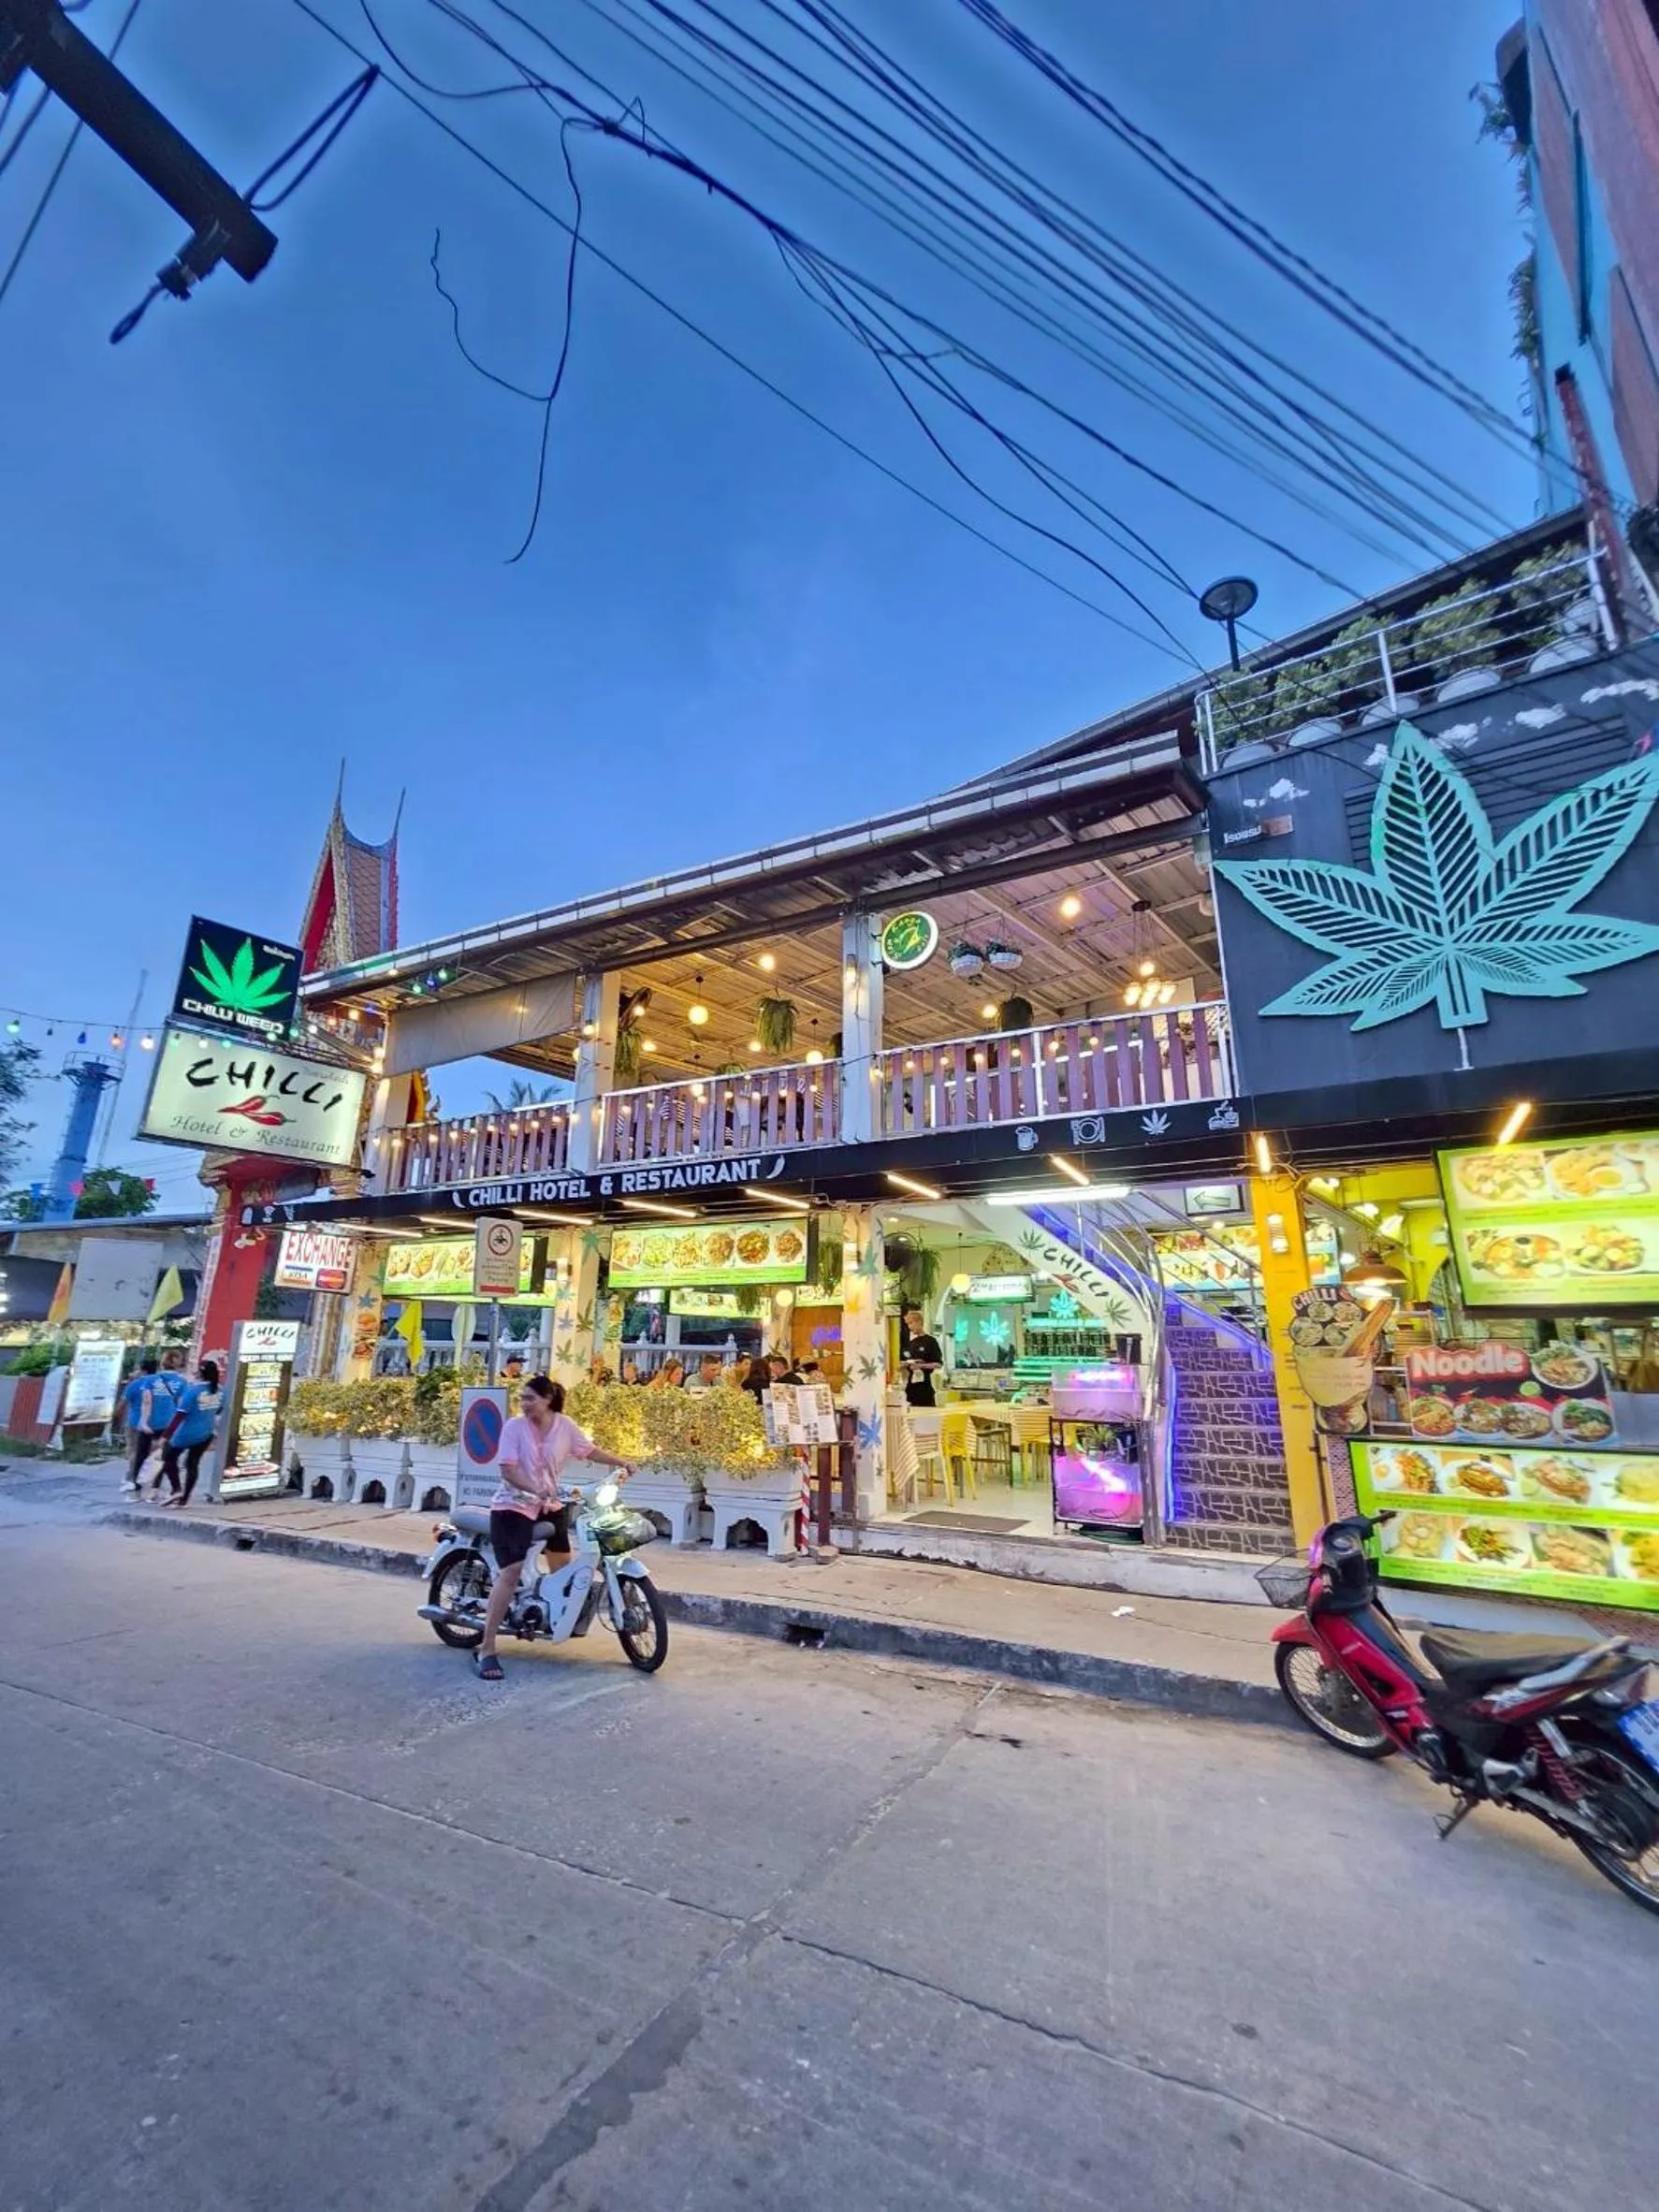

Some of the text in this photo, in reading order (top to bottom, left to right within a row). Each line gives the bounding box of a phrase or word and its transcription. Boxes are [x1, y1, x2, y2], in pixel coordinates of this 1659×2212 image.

[182, 997, 284, 1035] CHILLI WEED
[185, 1057, 342, 1112] CHILLI
[170, 1114, 342, 1156] Hotel & Restaurant
[468, 1158, 762, 1207] CHILLI HOTEL & RESTAURANT
[285, 1230, 354, 1269] EXCHANGE
[1043, 1248, 1110, 1298] CHILLI
[1293, 1288, 1338, 1311] CHILLI
[1411, 1343, 1523, 1377] Noodle
